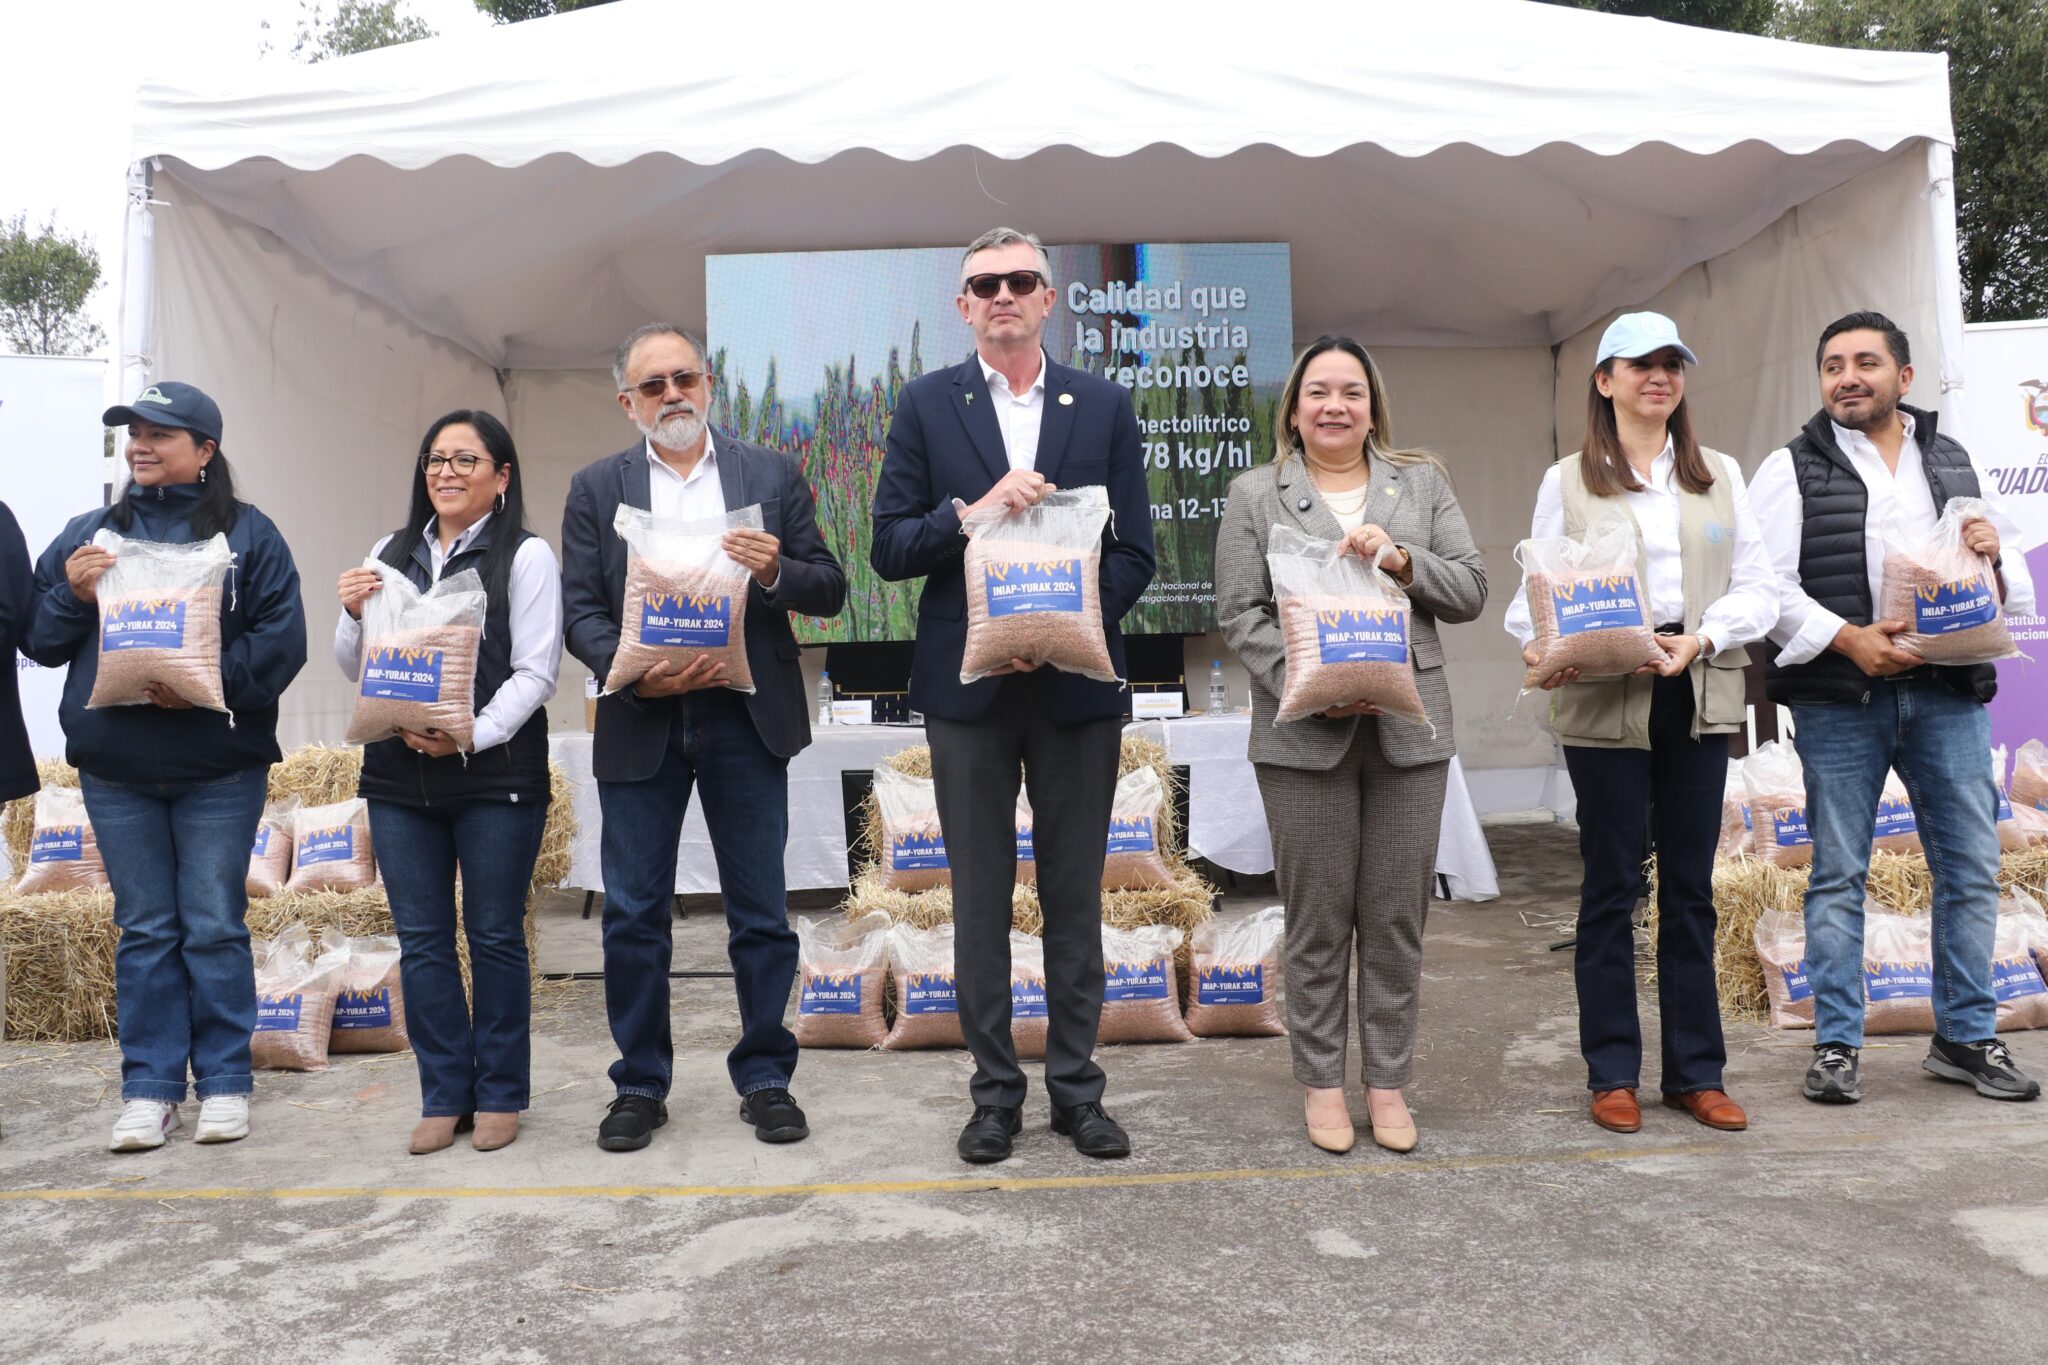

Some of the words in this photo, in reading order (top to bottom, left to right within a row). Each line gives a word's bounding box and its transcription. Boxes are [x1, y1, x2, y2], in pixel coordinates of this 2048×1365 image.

[1068, 281, 1181, 314] Calidad
[1191, 286, 1246, 317] que
[1076, 321, 1104, 353] la
[1110, 318, 1248, 353] industria
[1104, 364, 1249, 389] reconoce
[1138, 413, 1250, 434] hectolítrico
[1141, 441, 1170, 469] 78
[1178, 441, 1251, 475] kg/hl
[993, 582, 1051, 597] INIAP-YURAK
[1053, 581, 1076, 592] 2024
[1160, 581, 1199, 591] Nacional
[1201, 581, 1212, 589] de
[1562, 600, 1617, 617] INIAP-YURAK
[1618, 598, 1636, 609] 2024
[1922, 601, 1976, 617] INIAP-YURAK
[1975, 595, 1990, 607] 2024
[106, 620, 153, 633] INIAP-YURAK
[154, 620, 177, 630] 2024
[647, 615, 702, 629] INIAP-YURAK
[703, 618, 724, 629] 2024
[1325, 631, 1382, 643] INIAP-YURAK
[1383, 632, 1402, 643] 2024
[366, 668, 411, 681] INIAP-YURAK
[411, 672, 434, 683] 2024
[62, 840, 77, 848] 2024
[1106, 977, 1148, 987] INIAP-YURAK
[1148, 976, 1163, 984] 2024
[1202, 982, 1241, 990] INIAP-YURAK
[1242, 982, 1258, 990] 2024
[839, 991, 856, 1000] 2024
[910, 991, 950, 999] INIAP-YURAK
[277, 1008, 295, 1017] 2024
[368, 1006, 386, 1014] 2024
